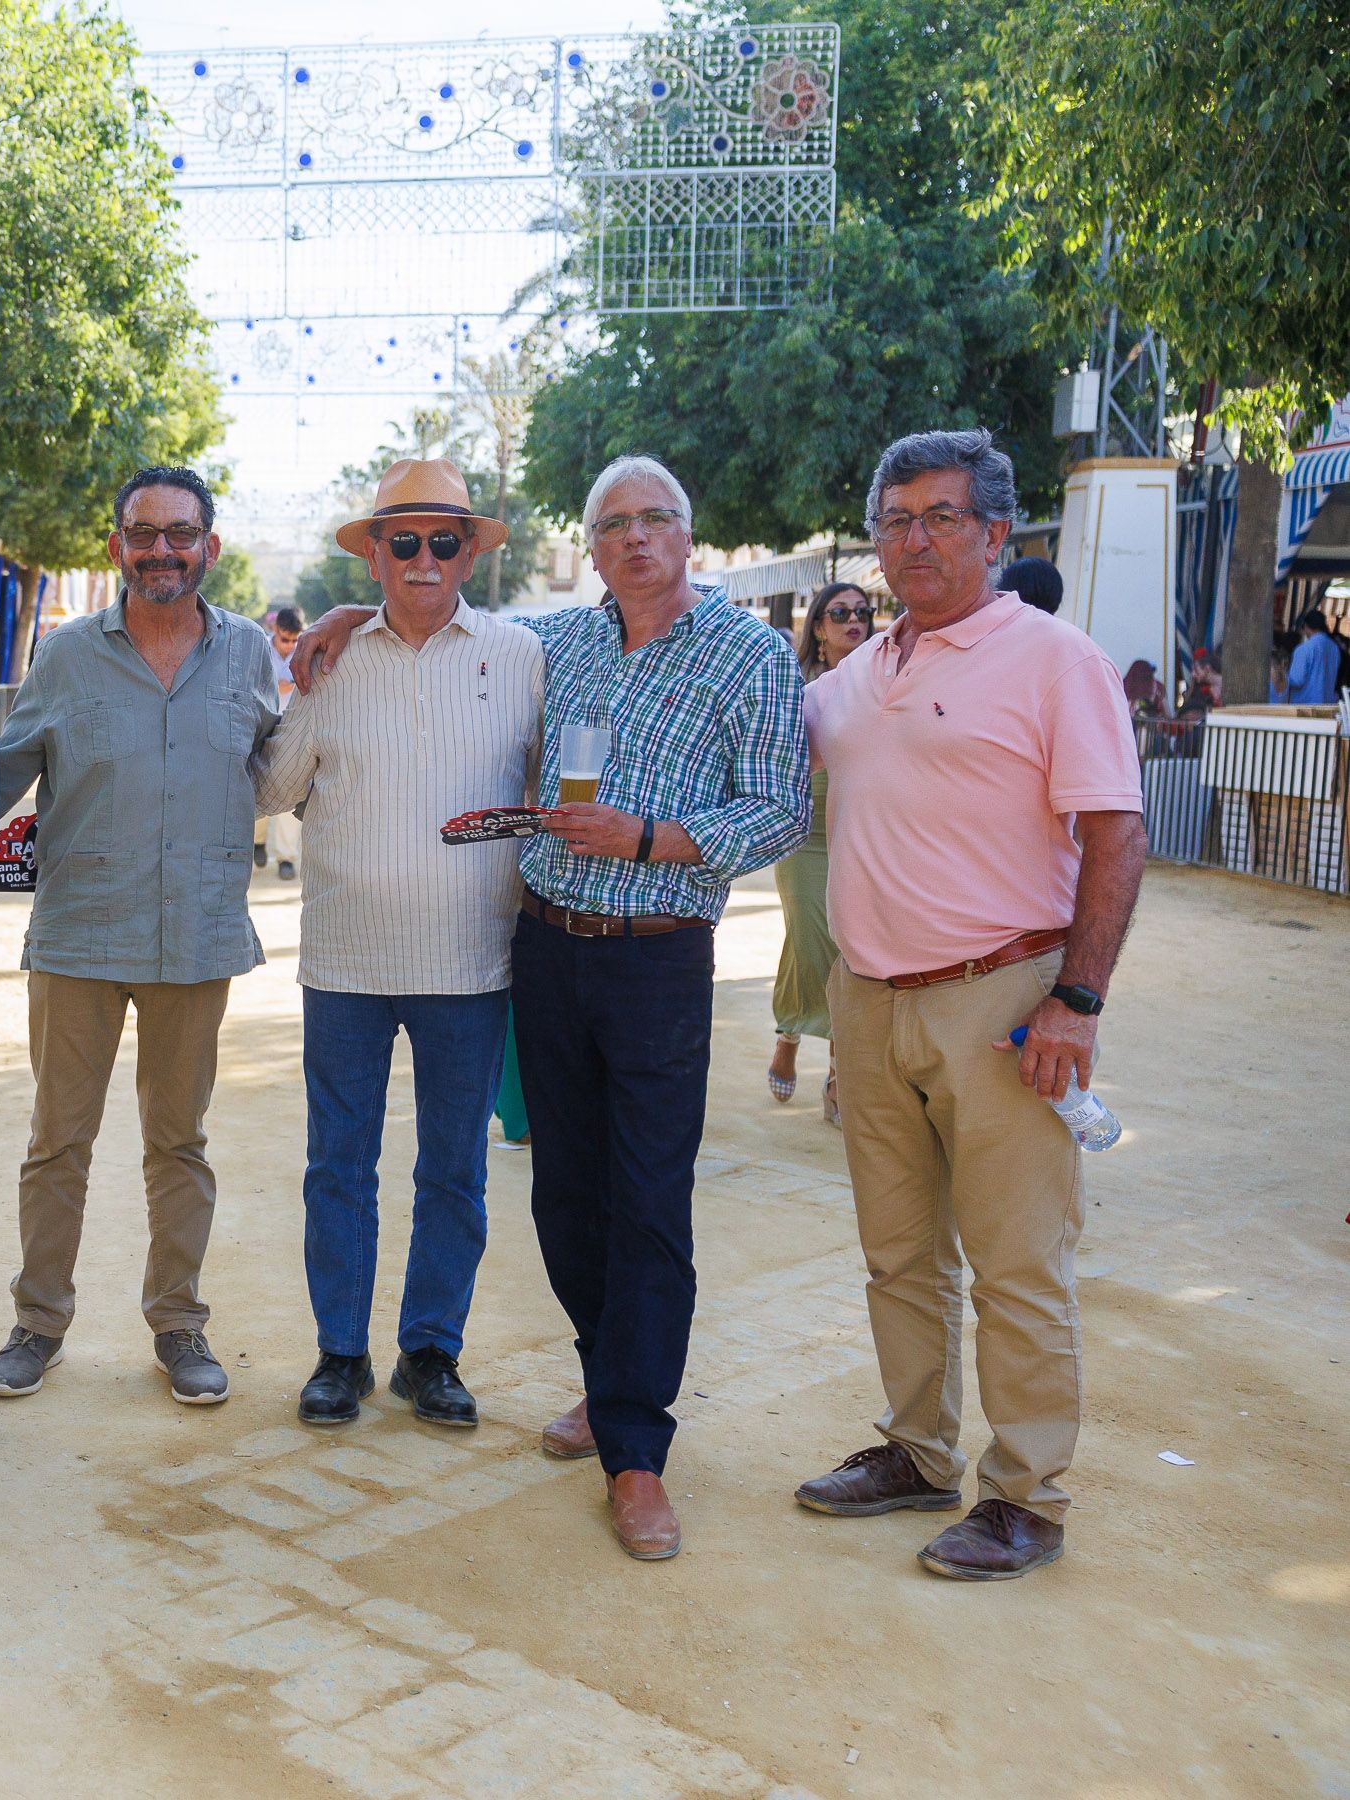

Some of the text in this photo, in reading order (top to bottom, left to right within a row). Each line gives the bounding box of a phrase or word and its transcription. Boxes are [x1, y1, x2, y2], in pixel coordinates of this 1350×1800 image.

[468, 814, 532, 826] RADIO
[447, 828, 484, 837] Gana
[462, 830, 497, 840] 100€
[0, 872, 30, 883] 100€
